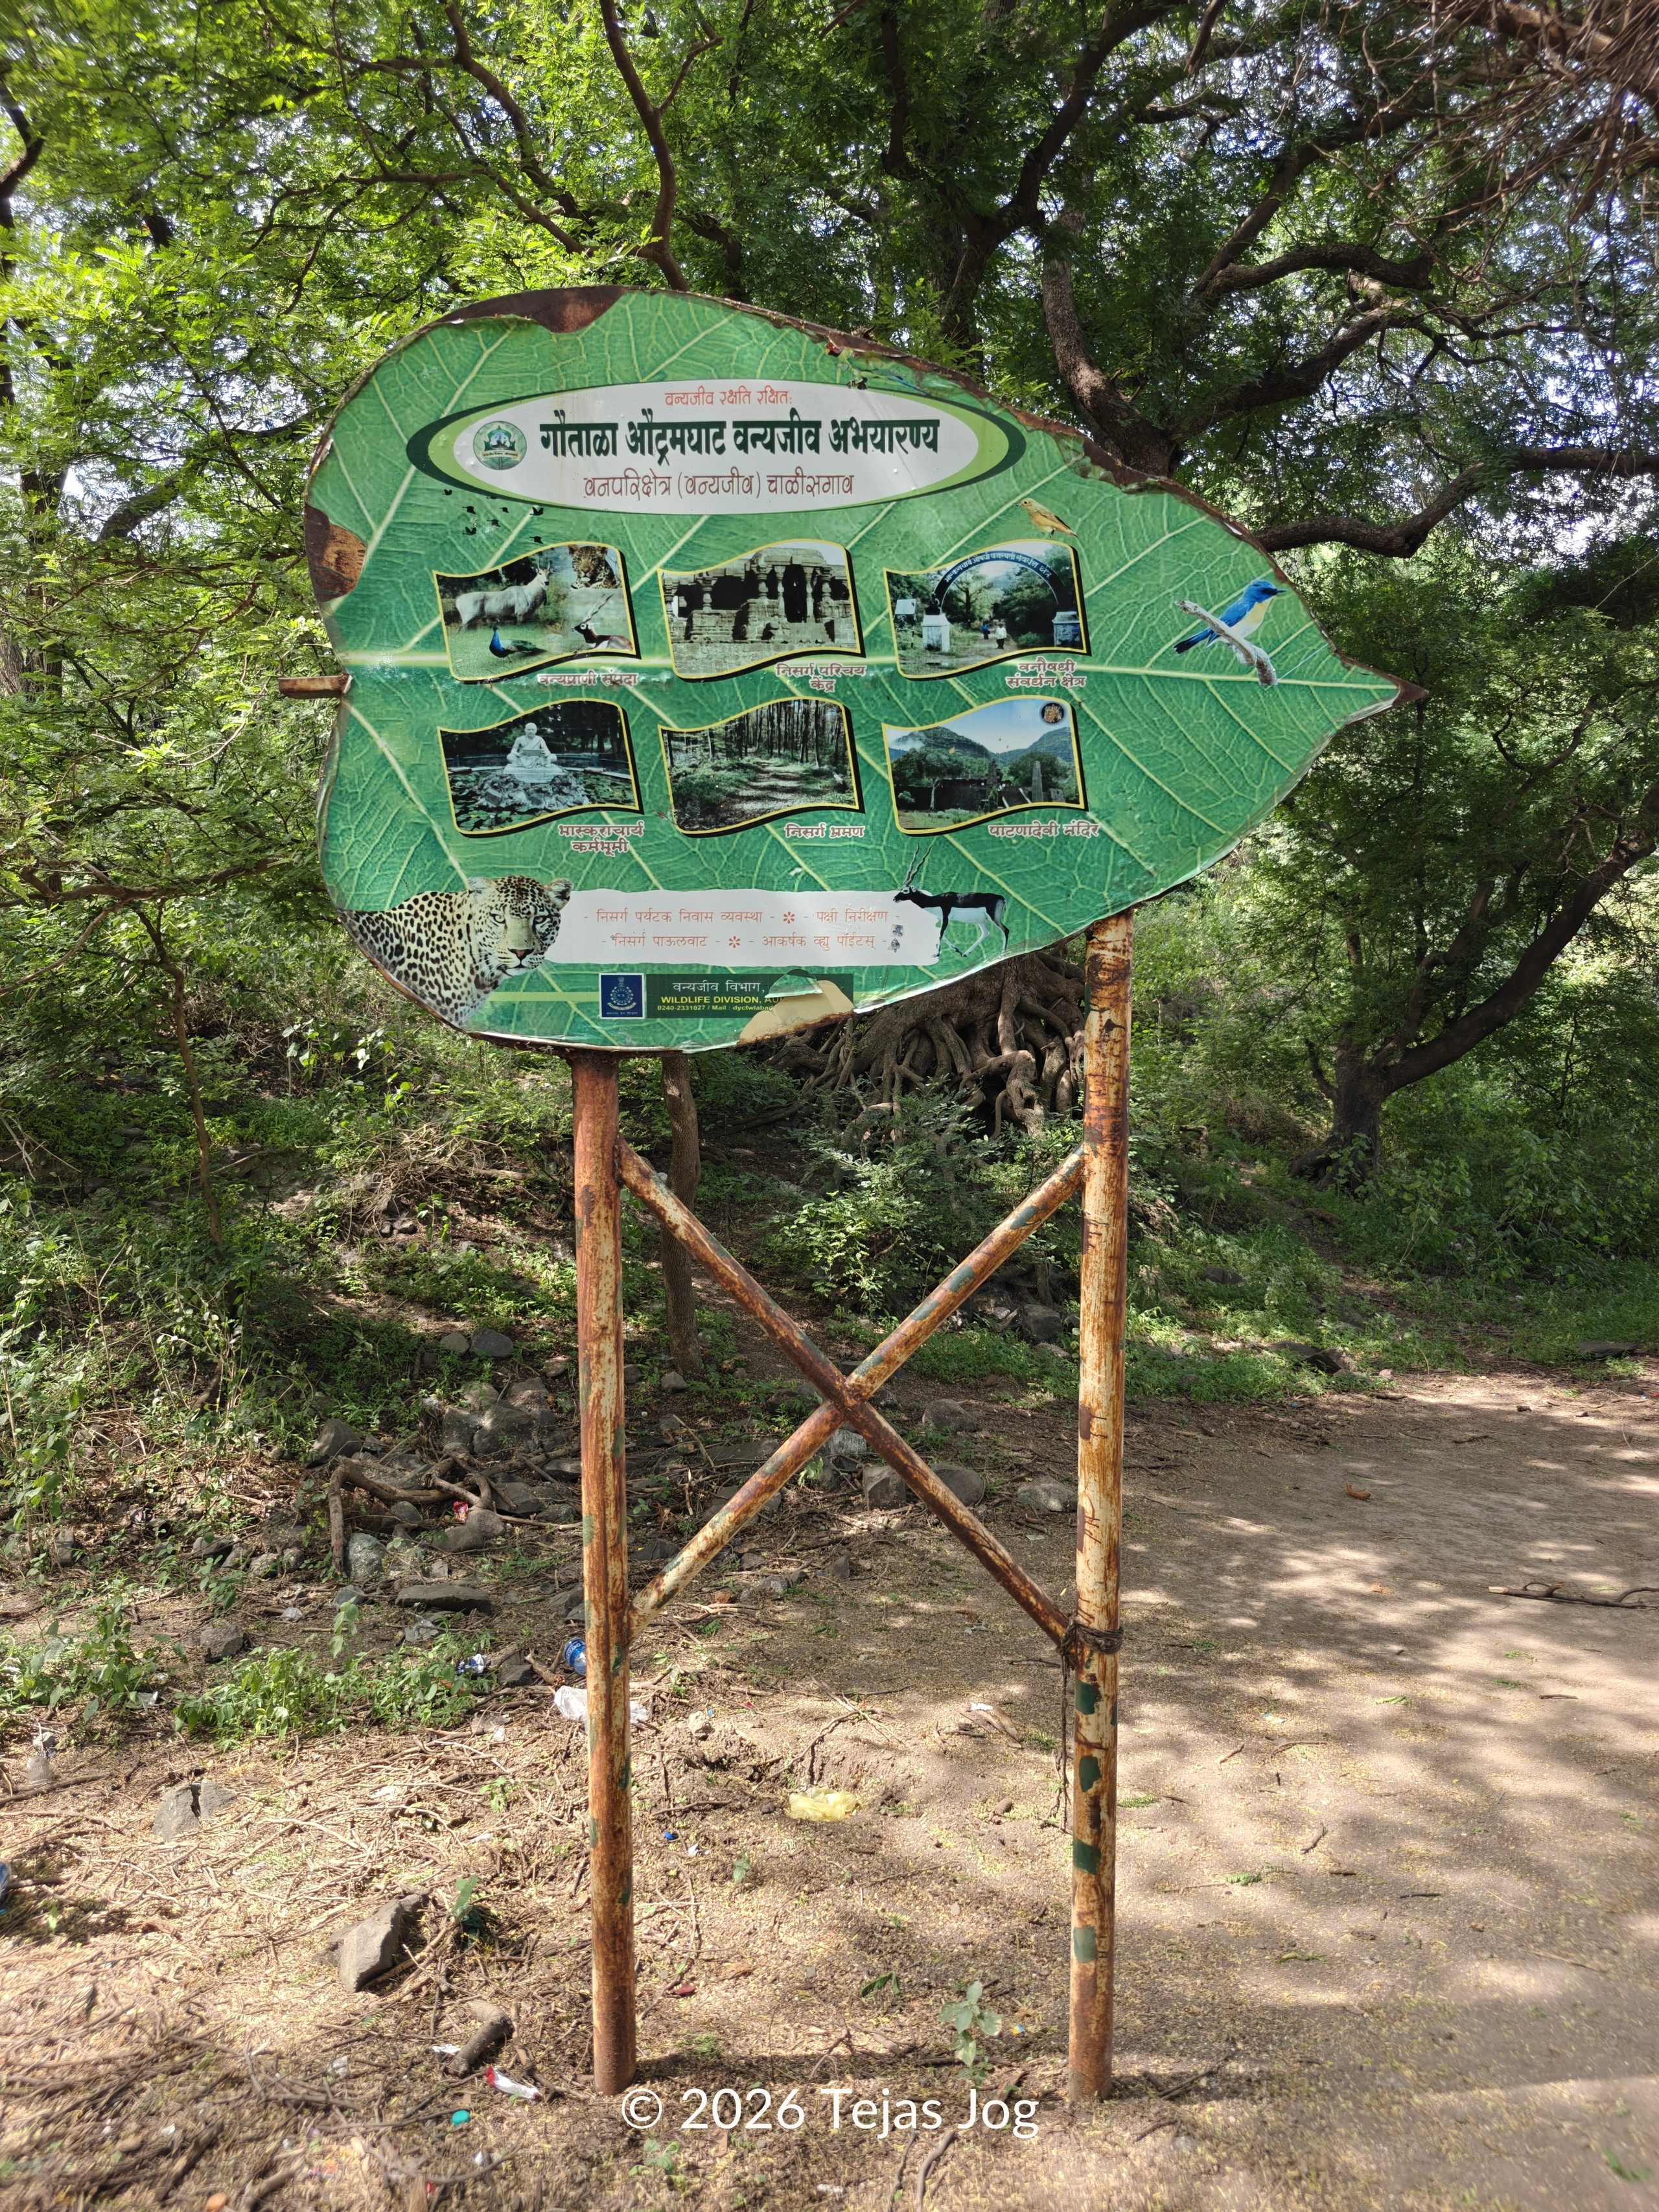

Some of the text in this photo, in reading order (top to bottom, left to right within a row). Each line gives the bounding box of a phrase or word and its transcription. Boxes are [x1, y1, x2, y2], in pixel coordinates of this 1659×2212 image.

[665, 386, 713, 406] वन्यजीव
[719, 385, 751, 405] रक्षति
[540, 408, 940, 466] गौताळा औट्रमघाट वन्यजीव अभयारण्य
[583, 466, 855, 501] वनपरिक्षेत्र (वन्यजीव) चाळीसगाव
[539, 669, 639, 686] वन्यप्राणी संपदा
[776, 662, 866, 677] निसर्ग परिचय
[810, 676, 836, 692] केंद्र
[1006, 673, 1087, 688] संवर्धन क्षेत्र
[558, 821, 644, 837] भास्कराचार्य
[785, 822, 865, 838] निसर्ग भ्रमण
[988, 819, 1100, 838] पाटणादेवी मंदिर
[571, 837, 629, 857] कर्मभूमी
[596, 907, 889, 924] निसर्ग पर्यटक निवास व्यवस्था पक्षी निरीक्षण
[615, 932, 646, 947] निसर्ग
[653, 936, 708, 947] पाऊलवाट
[762, 932, 807, 947] आकर्षक
[672, 979, 765, 993] वन्यजीव विभाग,
[713, 995, 761, 1004] DIVISION,
